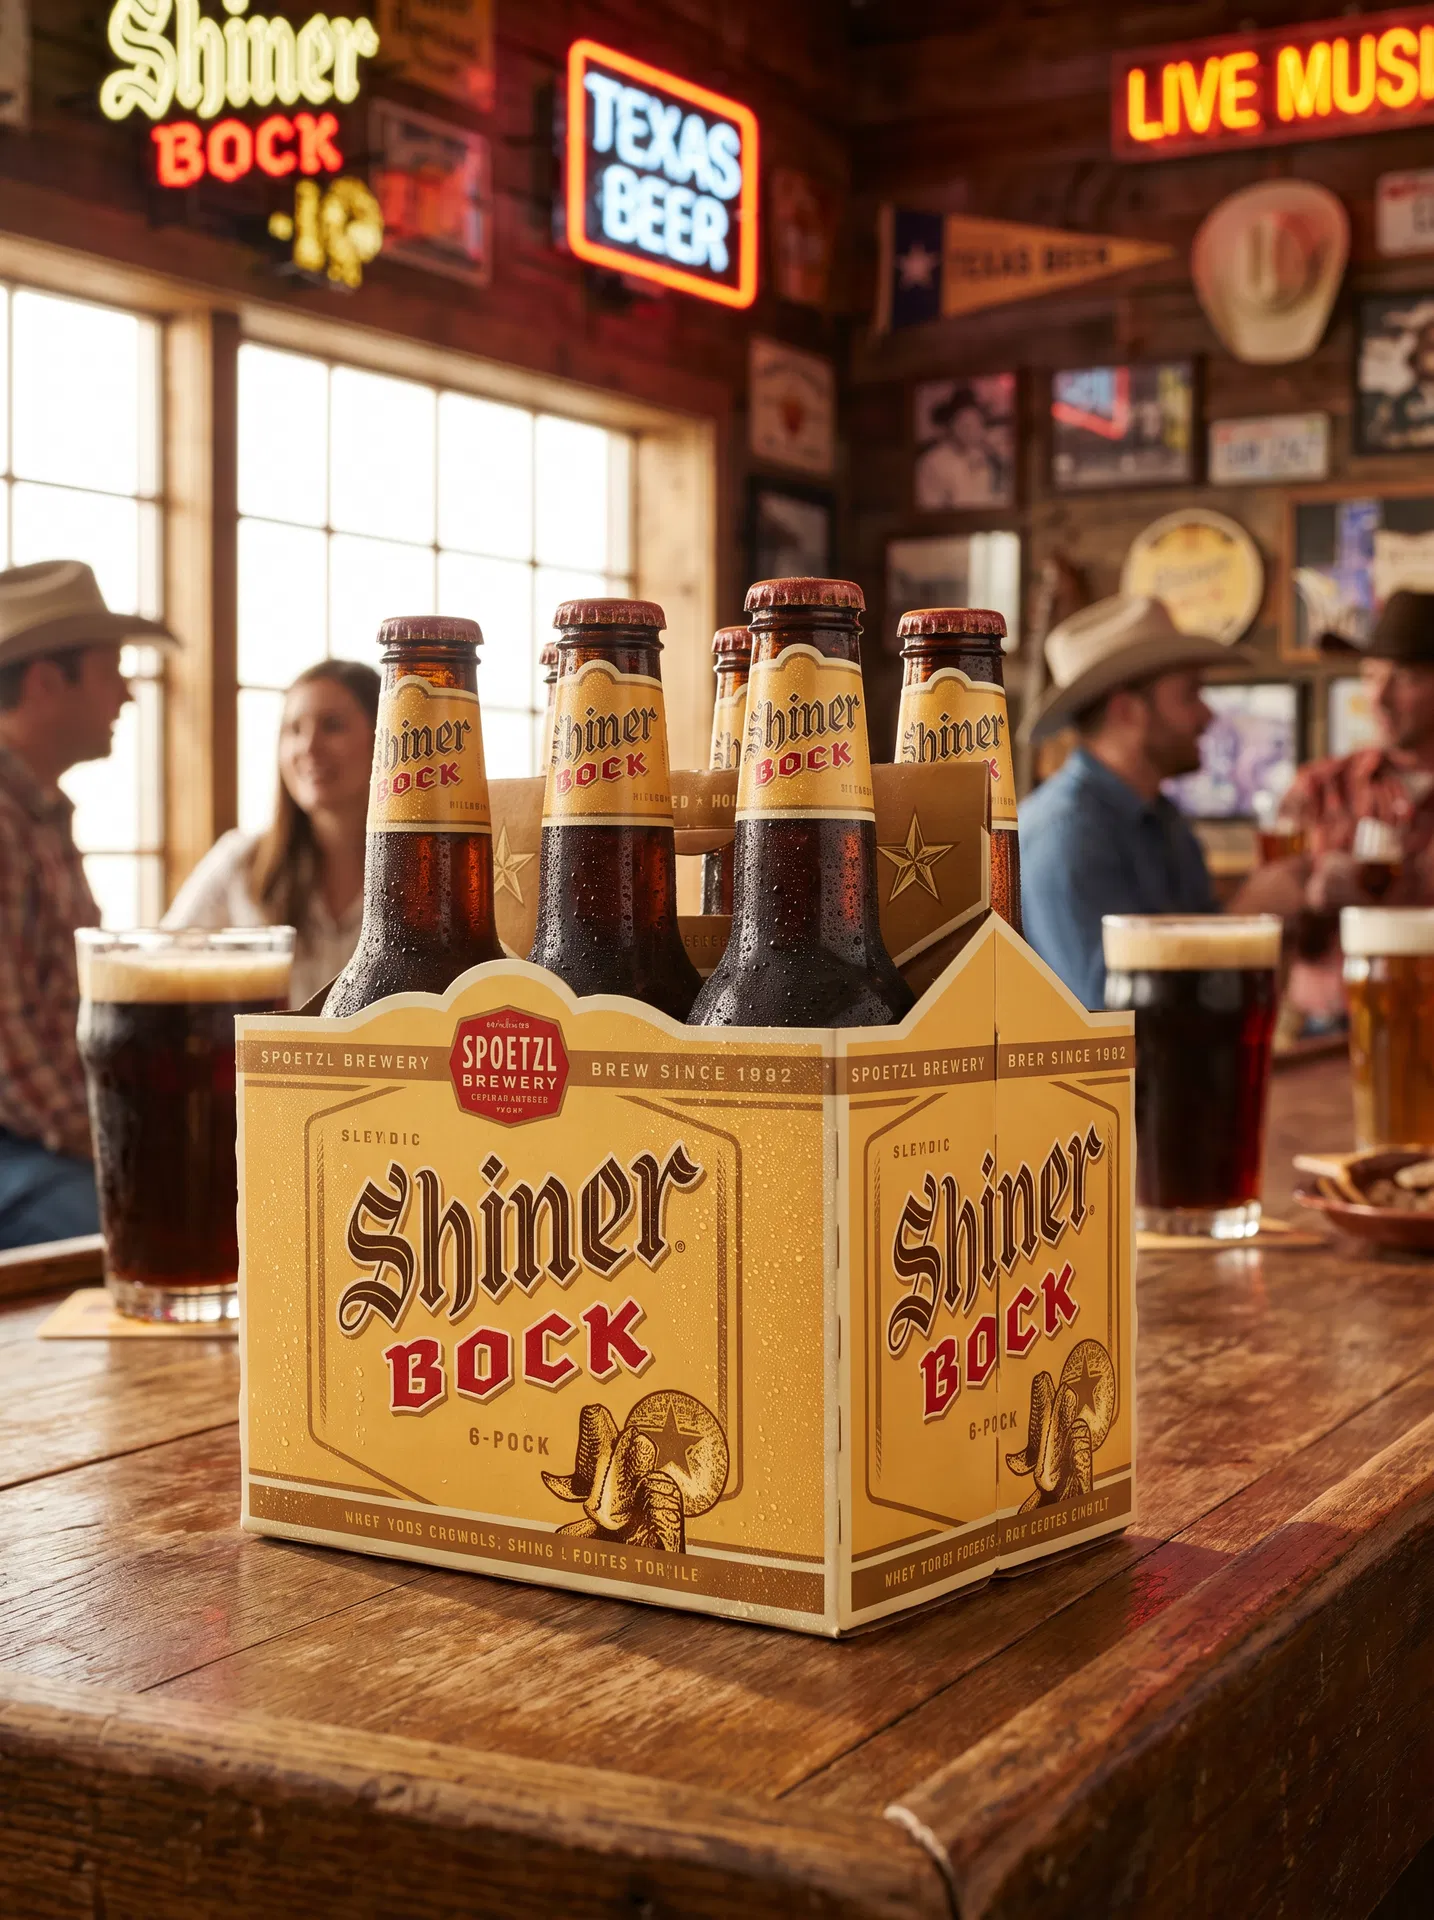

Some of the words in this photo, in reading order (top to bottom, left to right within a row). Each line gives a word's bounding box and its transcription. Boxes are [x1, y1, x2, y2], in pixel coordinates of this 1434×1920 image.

[100, 0, 380, 120] Shiner
[1127, 50, 1260, 141] LIVE
[151, 112, 343, 188] BOCK
[583, 72, 742, 200] TEXAS
[602, 164, 729, 273] BEER
[376, 762, 462, 803] BOCK
[556, 752, 649, 795] BOCK
[756, 741, 852, 788] BOCK
[261, 1050, 335, 1067] SPOETZL
[344, 1053, 430, 1070] BREWERY
[462, 1034, 557, 1072] SPOETZL
[591, 1062, 649, 1078] BREW
[660, 1064, 725, 1081] SINCE
[851, 1063, 917, 1083] SPOETZL
[923, 1056, 985, 1077] BREWERY
[1008, 1051, 1044, 1068] BRER
[1051, 1047, 1091, 1065] SINCE
[1095, 1046, 1126, 1062] 1982
[462, 1074, 557, 1090] BREWERY
[336, 1138, 705, 1337] Shiner
[886, 1120, 1103, 1357] Shiner
[381, 1295, 655, 1418] BOCK
[919, 1259, 1081, 1423] BOCK
[469, 1427, 549, 1456] 6-POCK
[969, 1410, 1018, 1441] 6-POCK
